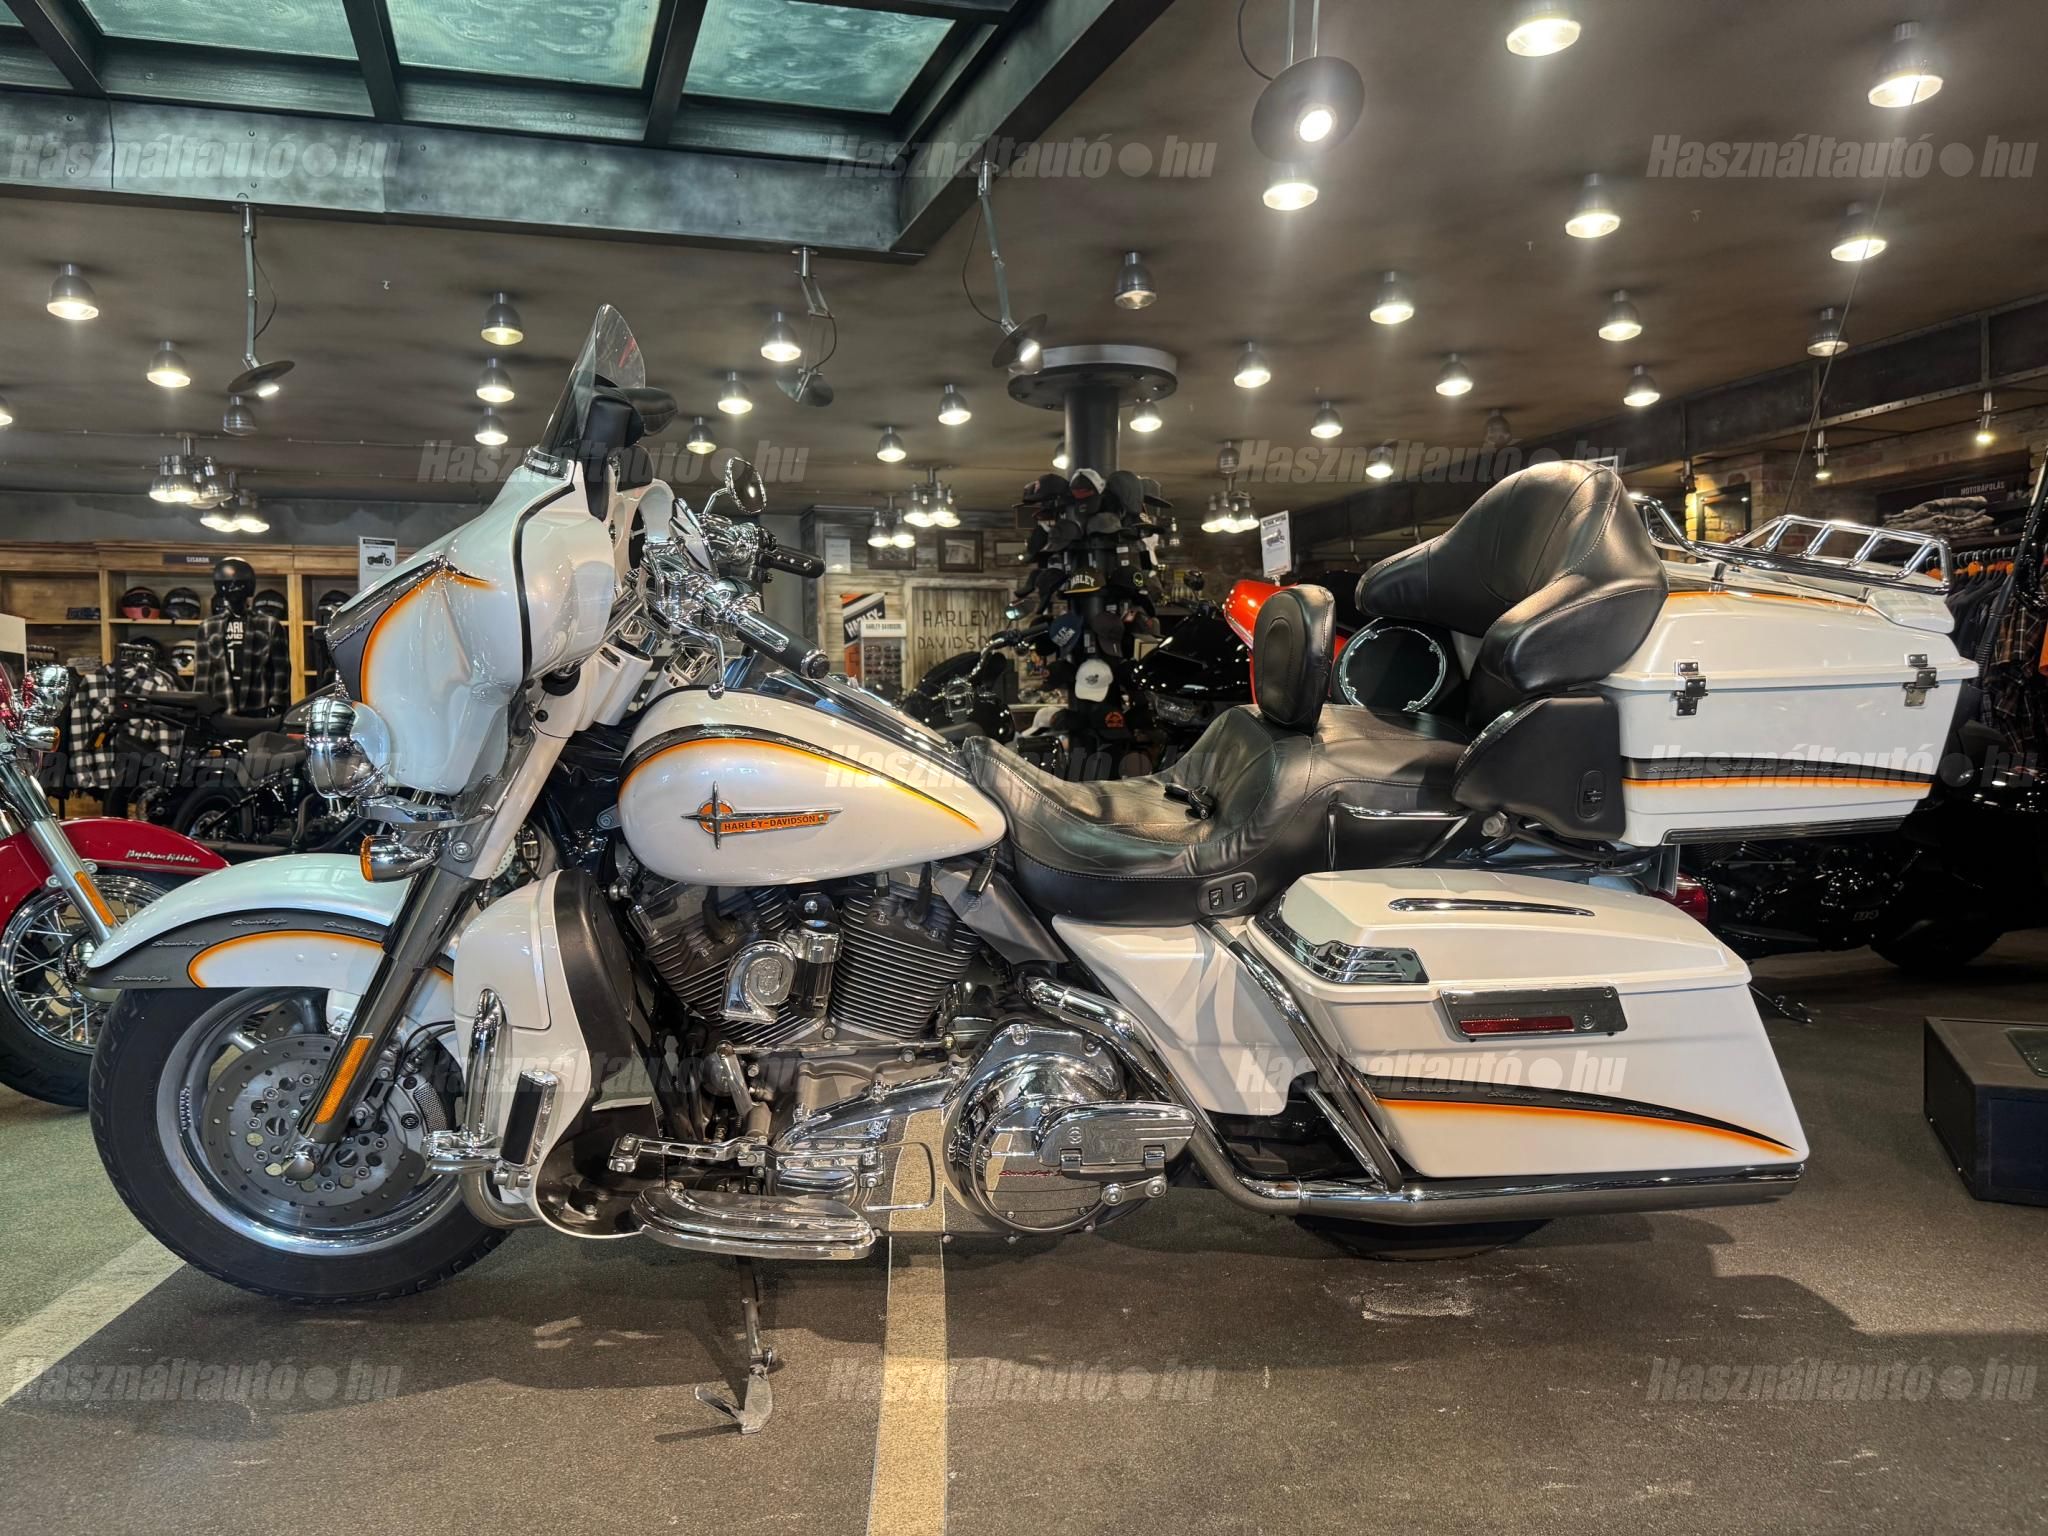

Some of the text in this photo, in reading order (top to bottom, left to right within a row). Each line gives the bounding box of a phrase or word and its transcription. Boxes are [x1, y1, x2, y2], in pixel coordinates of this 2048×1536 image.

[923, 610, 990, 628] HARLEY
[917, 636, 992, 650] DAVIDSO
[724, 815, 816, 831] HARLEY-DAVIDSON
